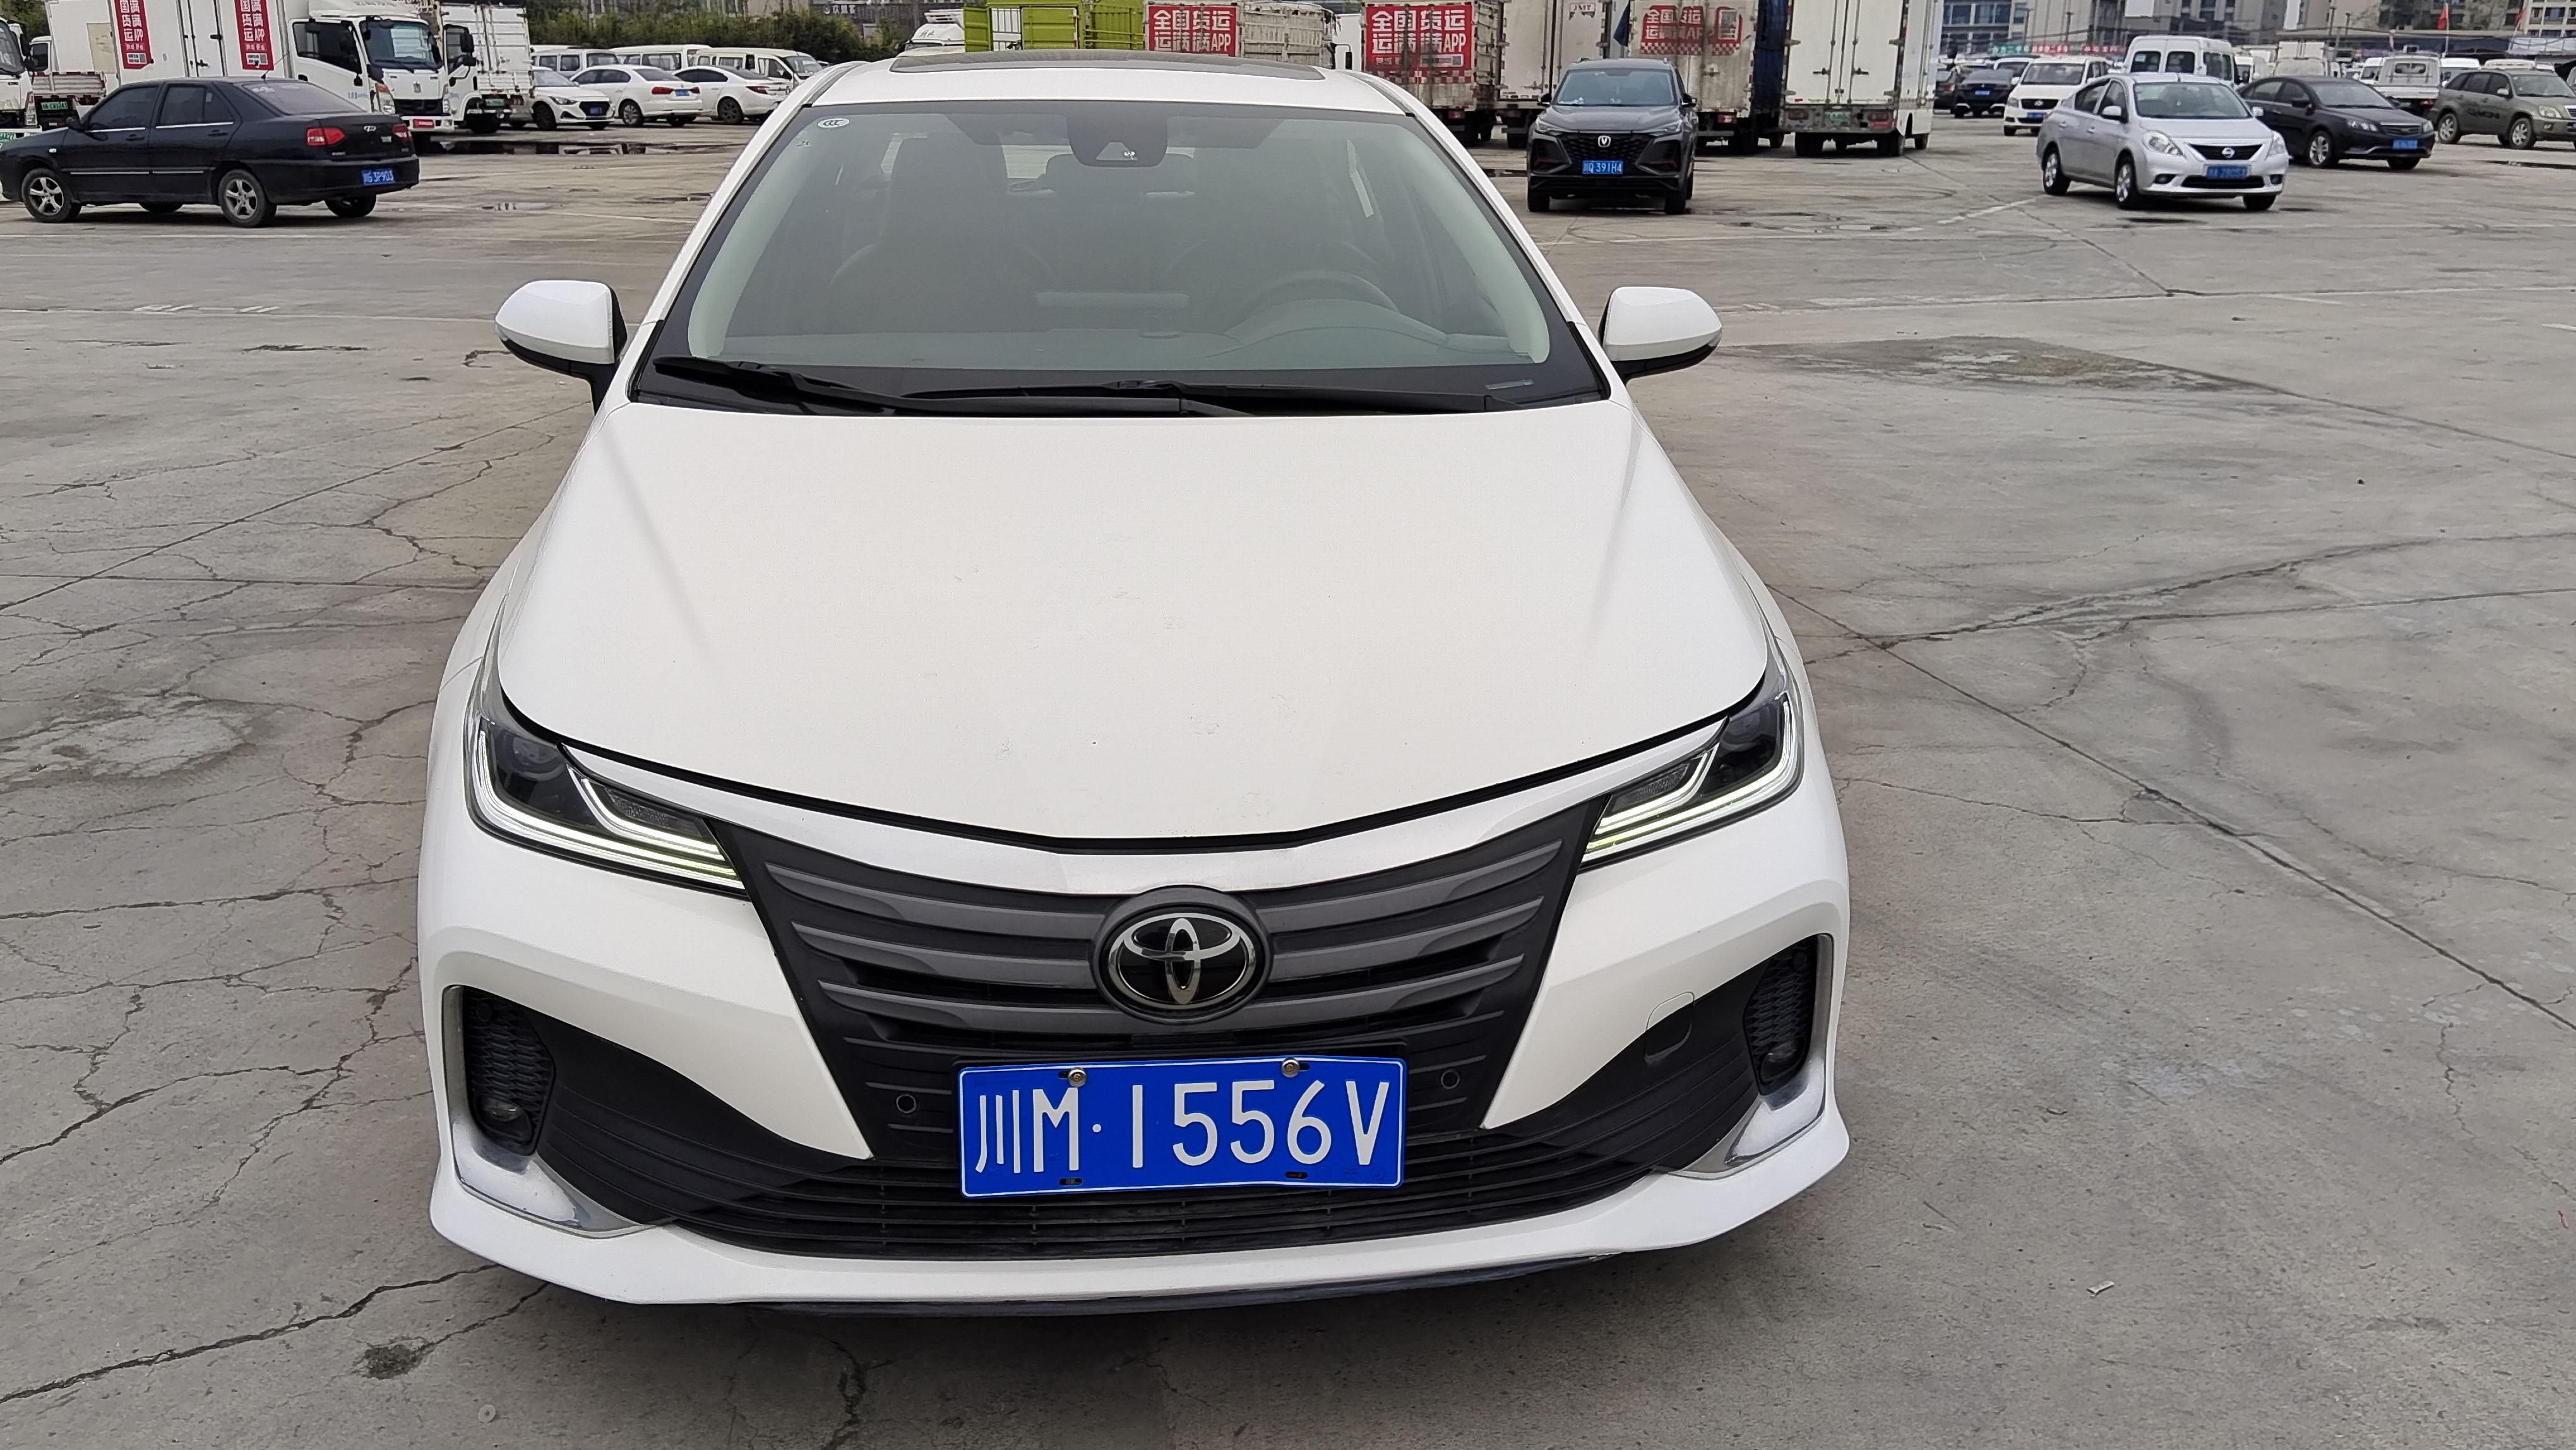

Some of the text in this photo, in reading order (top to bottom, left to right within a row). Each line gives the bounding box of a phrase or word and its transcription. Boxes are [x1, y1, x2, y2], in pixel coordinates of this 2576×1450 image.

[1153, 9, 1231, 30] 全国货运
[1371, 9, 1465, 32] 全国货运
